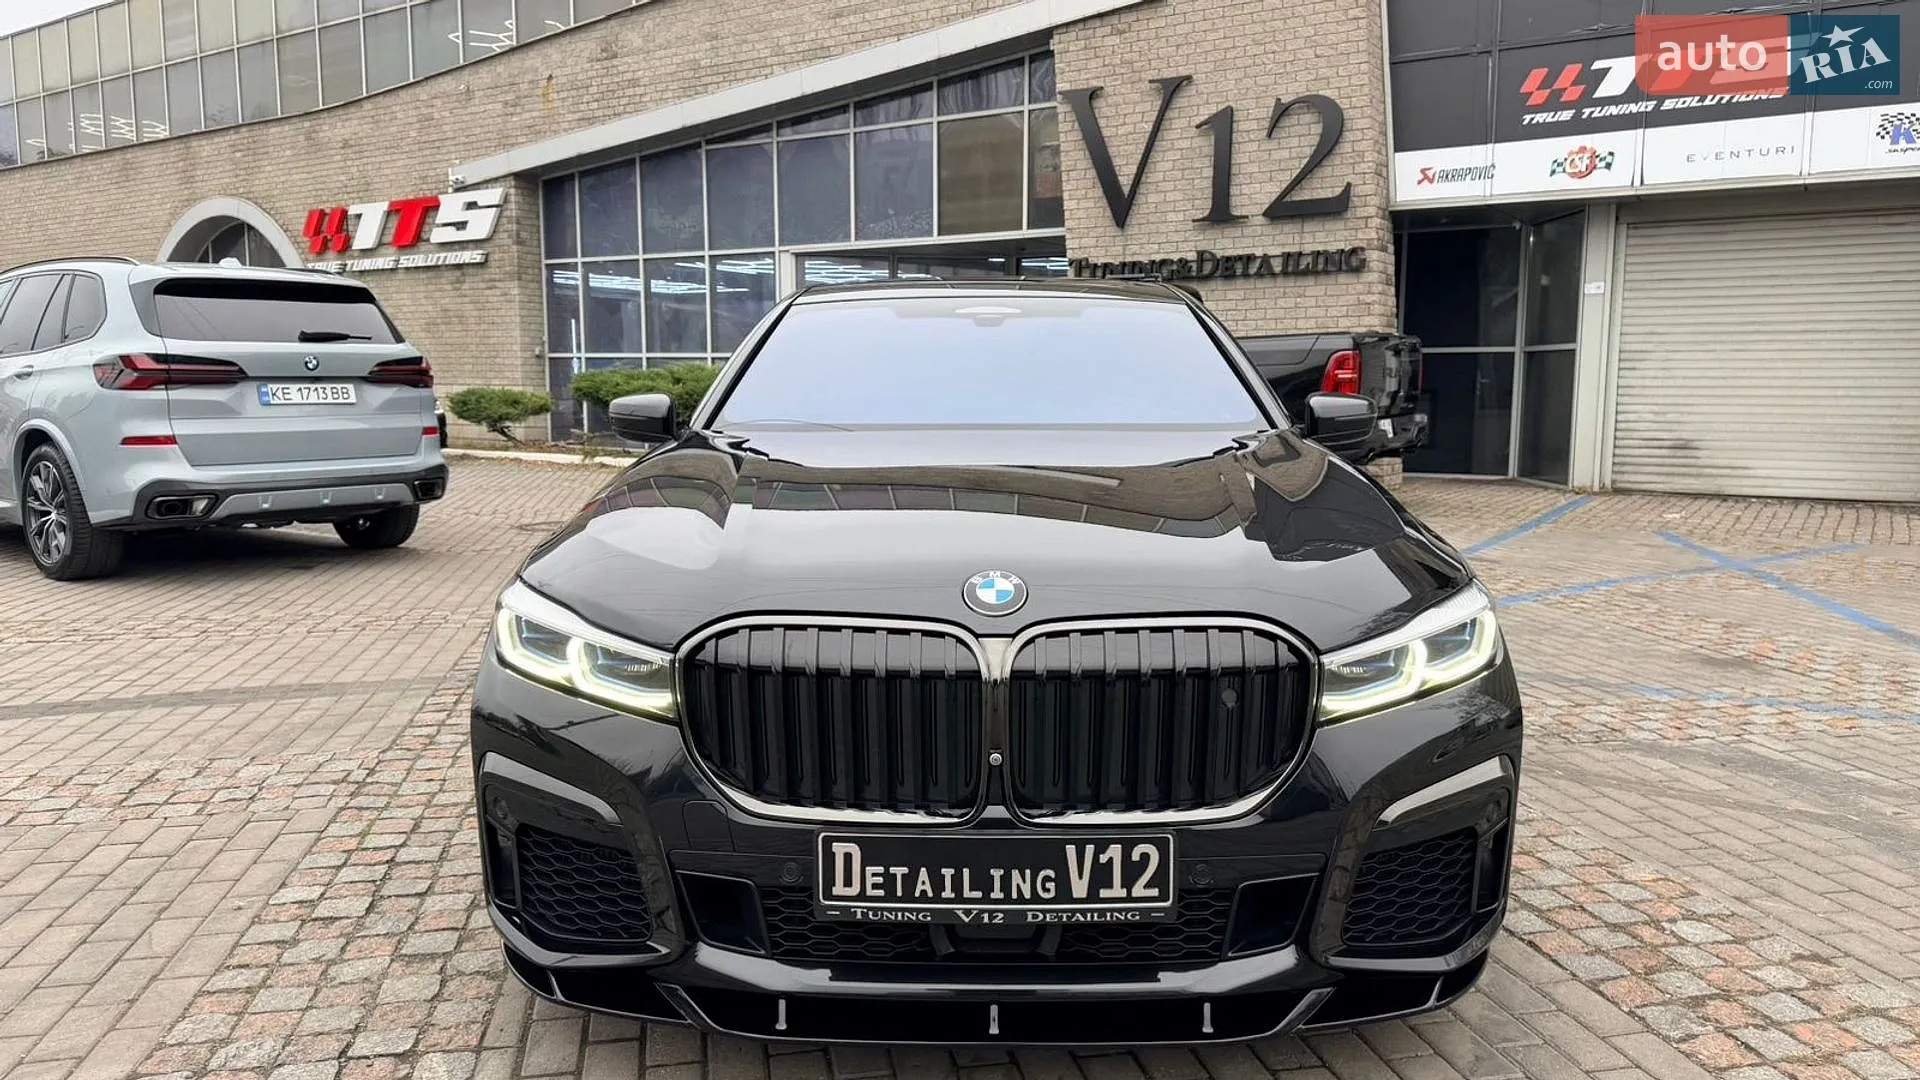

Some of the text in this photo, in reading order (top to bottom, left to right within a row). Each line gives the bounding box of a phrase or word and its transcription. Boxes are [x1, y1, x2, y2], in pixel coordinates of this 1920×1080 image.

[1521, 87, 1790, 125] TRUE TUNING SOLUTIONS
[1059, 75, 1352, 229] V12
[1686, 145, 1795, 163] EVENTURI
[348, 187, 509, 250] TTS
[345, 256, 397, 272] TUNING
[397, 250, 489, 268] SOLUTIONS
[1065, 843, 1161, 899] V12
[954, 910, 1004, 923] V12
